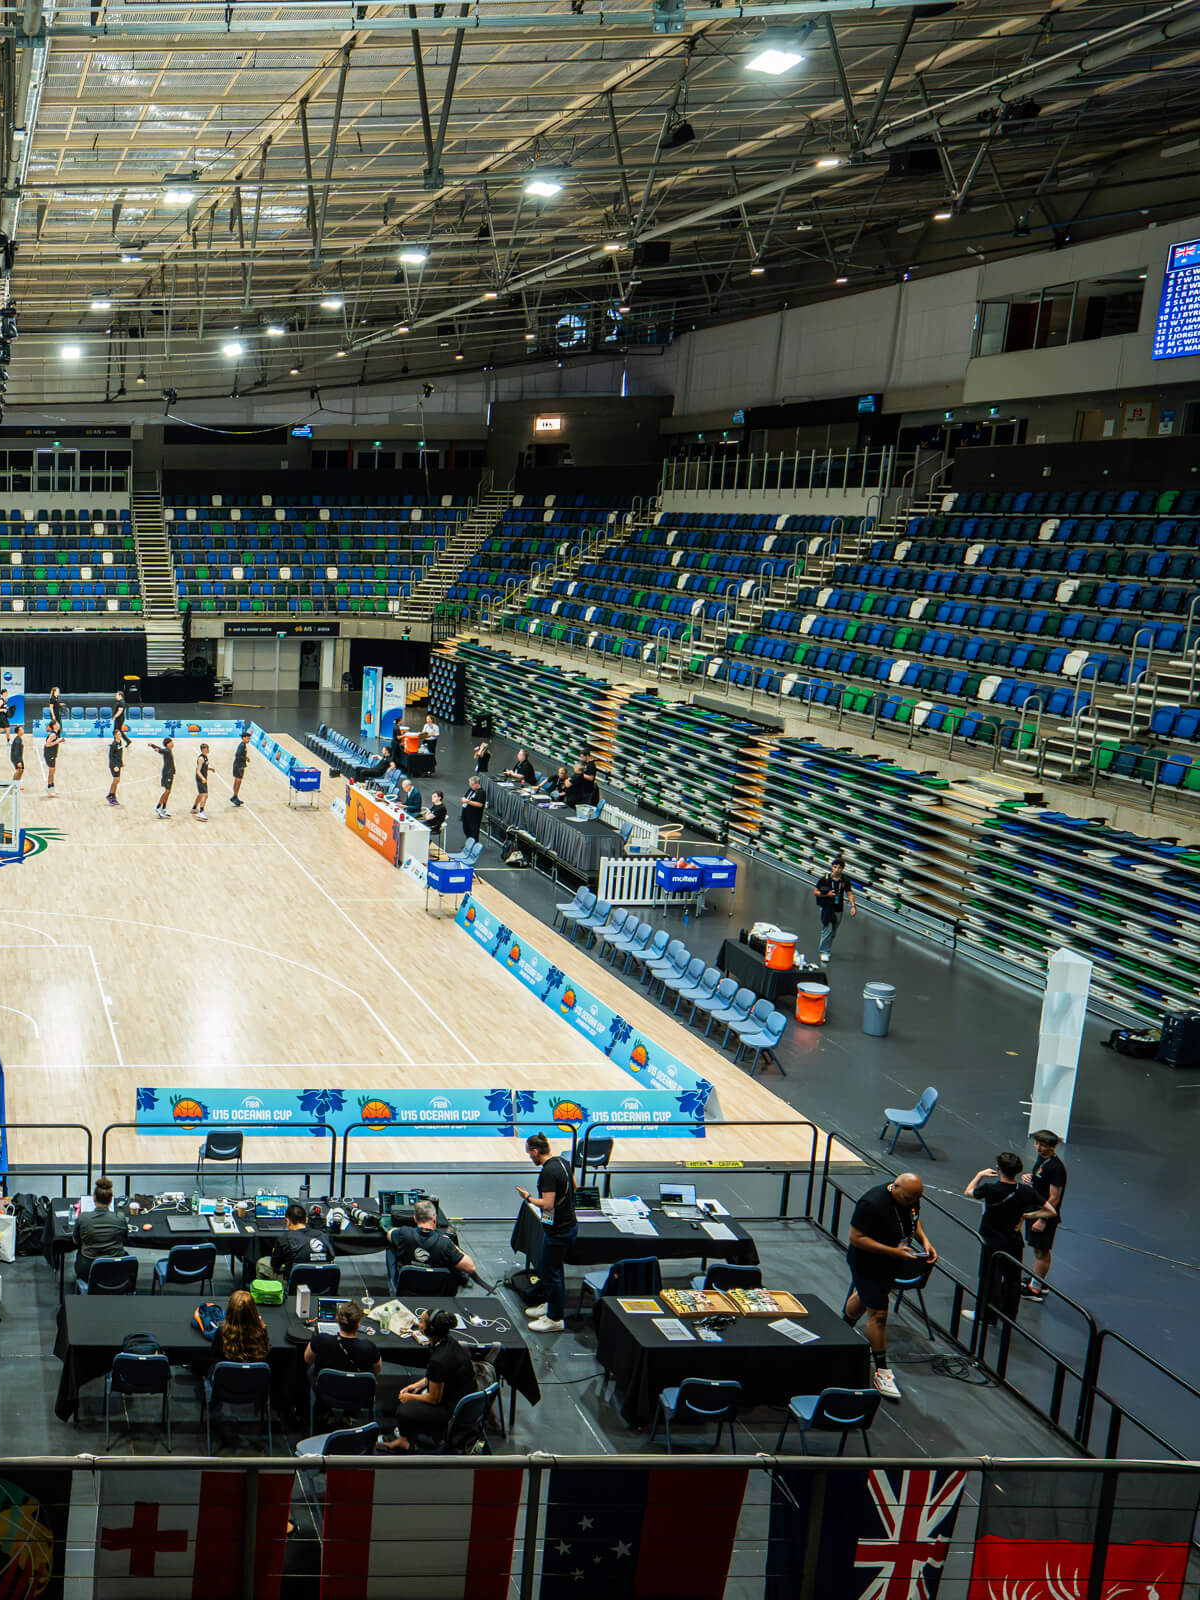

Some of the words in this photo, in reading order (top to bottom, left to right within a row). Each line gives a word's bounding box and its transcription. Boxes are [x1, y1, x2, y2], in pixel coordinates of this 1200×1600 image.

[245, 1100, 260, 1108] FIBA
[433, 1101, 448, 1109] FIBA
[624, 1102, 639, 1110] FIBA
[212, 1110, 230, 1120] U15
[231, 1110, 272, 1120] OCEANIA
[273, 1110, 293, 1120] CUP
[401, 1110, 418, 1121] U15
[420, 1110, 460, 1121] OCEANIA
[461, 1110, 481, 1121] CUP
[592, 1111, 609, 1122] U15
[611, 1111, 650, 1122] OCEANIA
[653, 1111, 672, 1122] CUP
